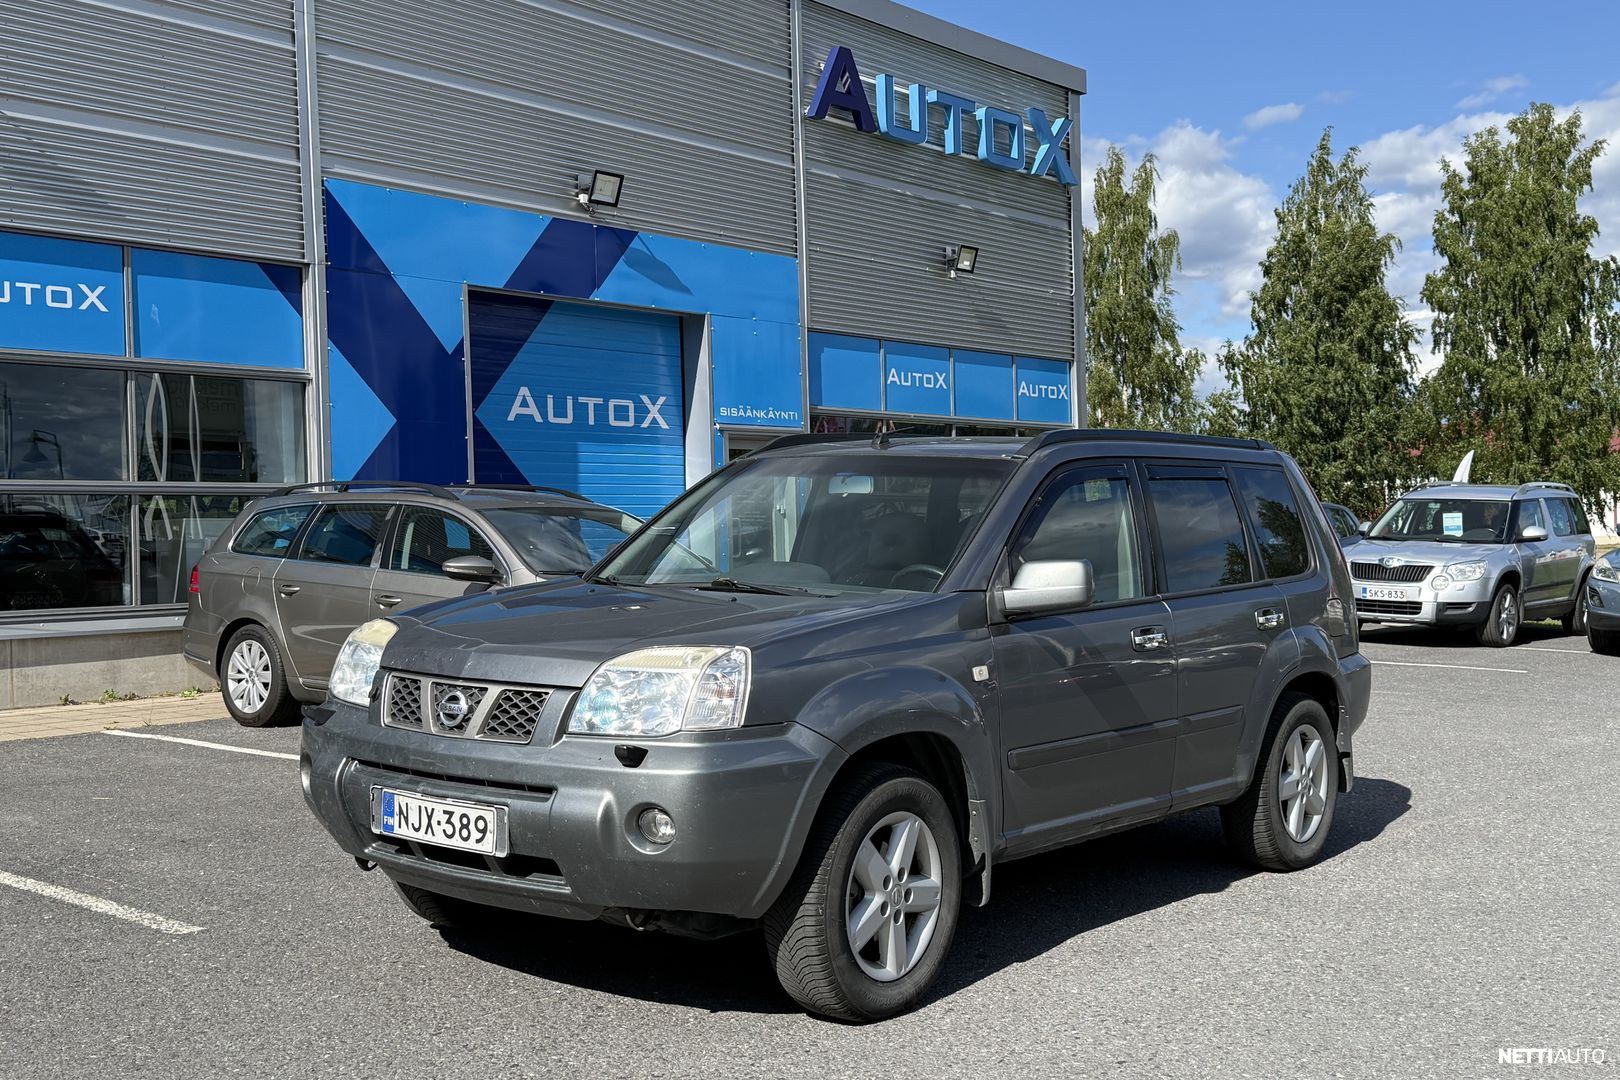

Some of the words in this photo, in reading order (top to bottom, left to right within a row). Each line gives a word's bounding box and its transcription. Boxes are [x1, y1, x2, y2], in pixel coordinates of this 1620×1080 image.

[805, 46, 1078, 185] AUTOX
[887, 367, 947, 389] AUTOX
[1018, 381, 1068, 400] AUTOX
[507, 386, 669, 429] AUTOX
[719, 405, 798, 421] SISÄÄNKÄYNTI
[1368, 589, 1405, 600] SKS-833
[383, 815, 394, 826] FIN
[398, 802, 488, 844] NJX-389
